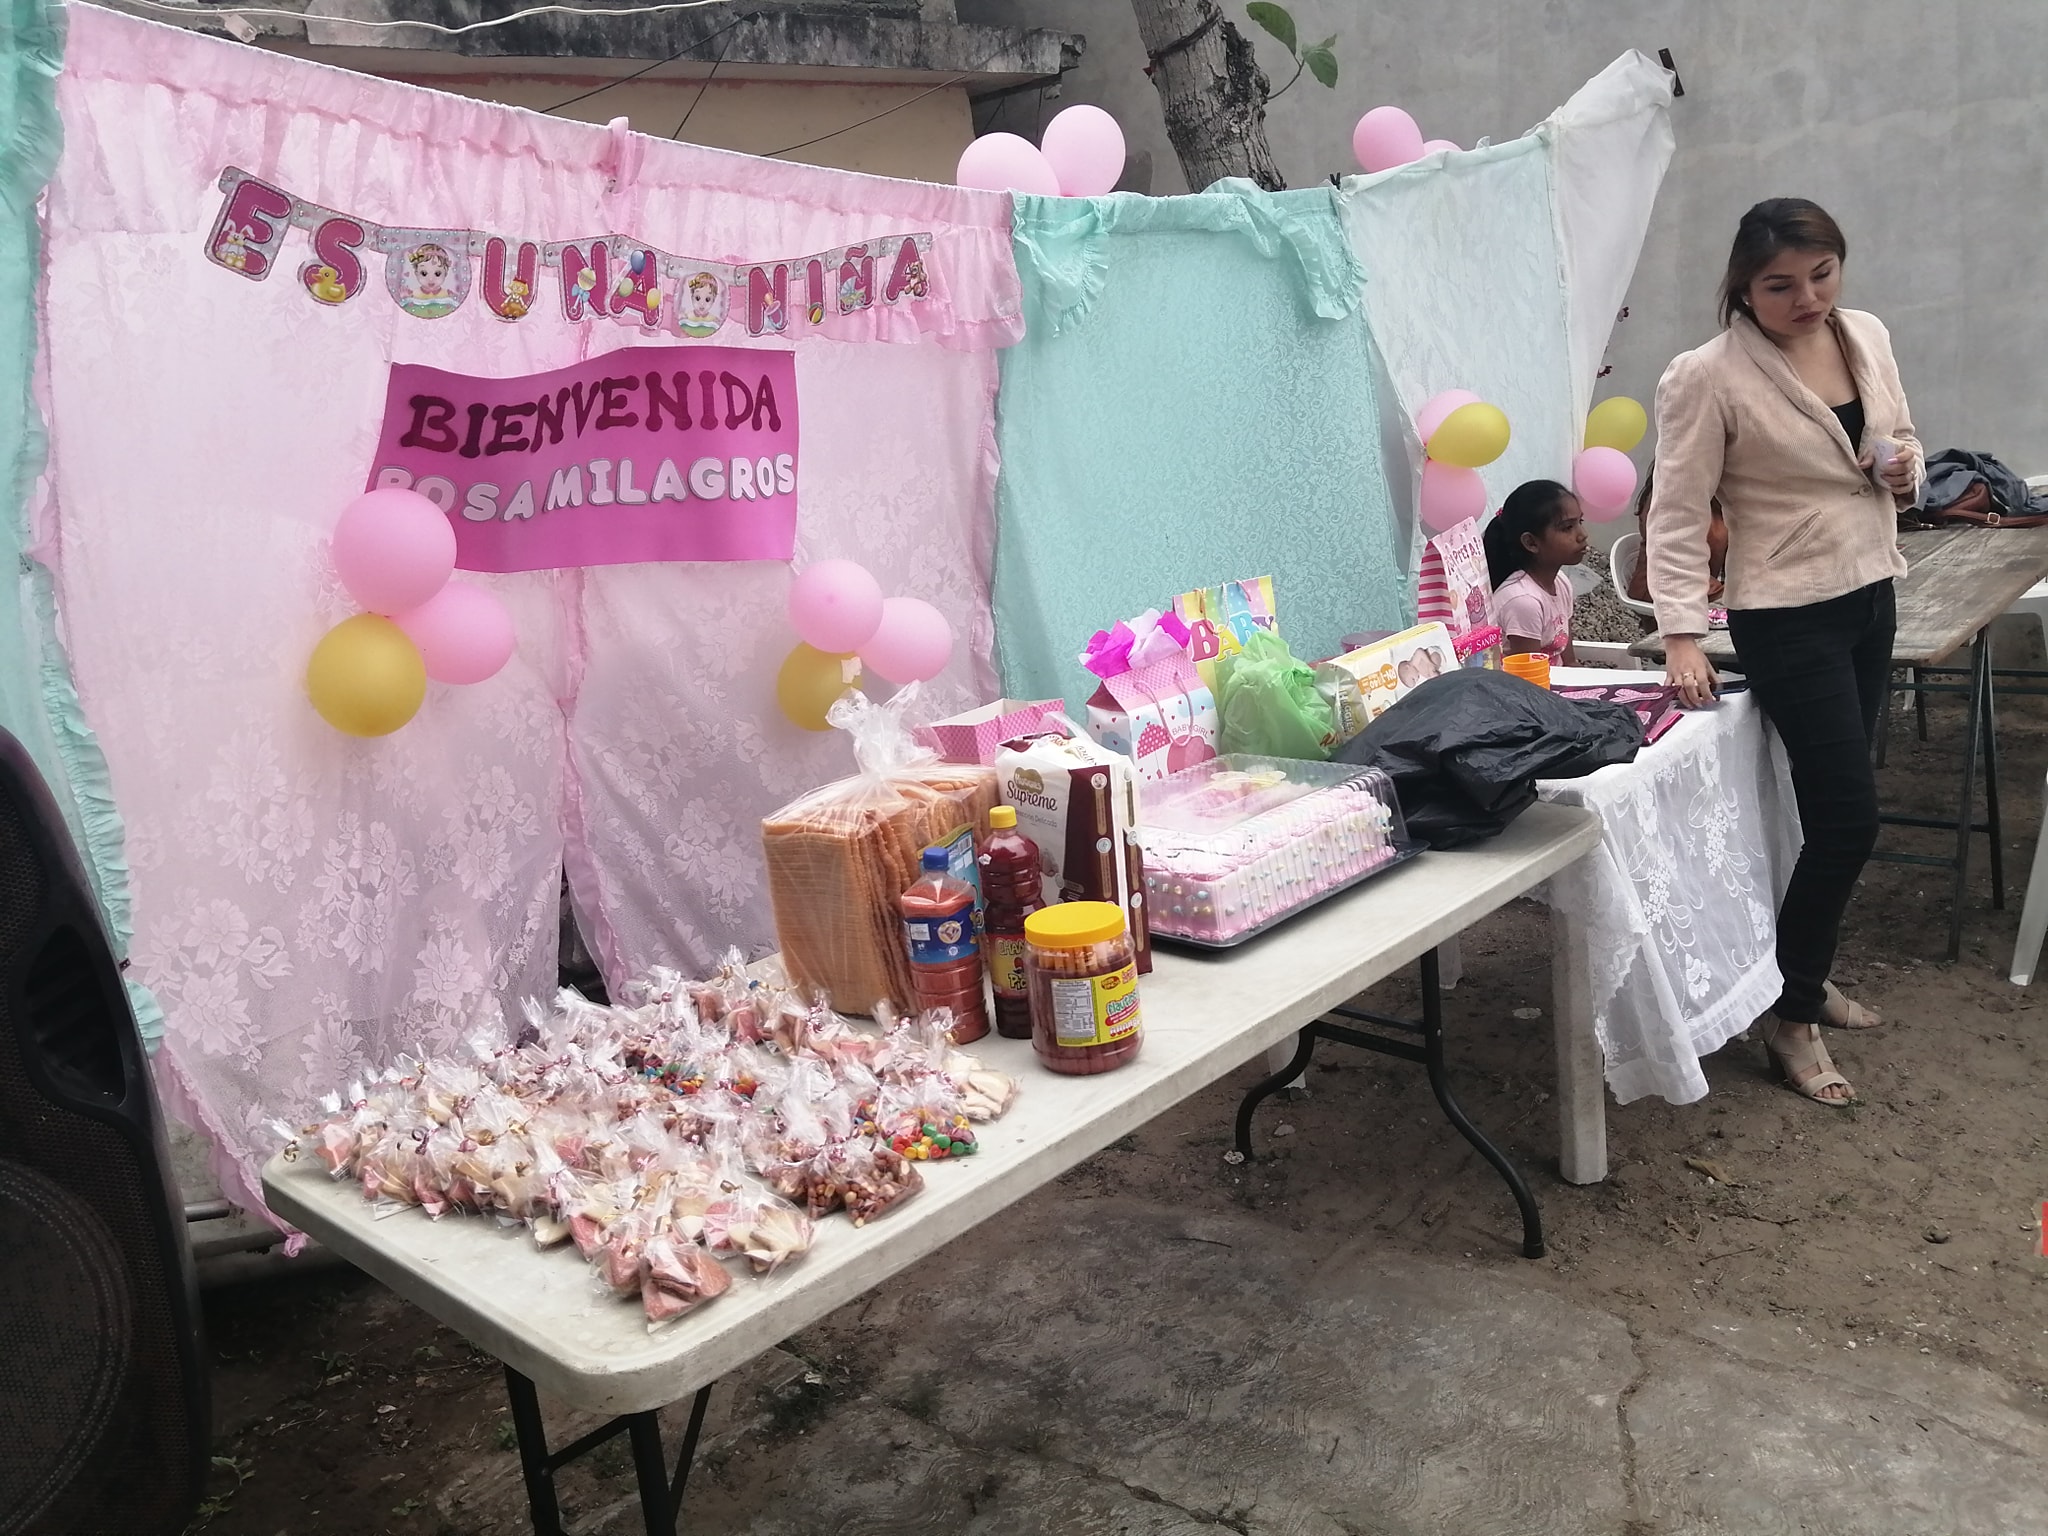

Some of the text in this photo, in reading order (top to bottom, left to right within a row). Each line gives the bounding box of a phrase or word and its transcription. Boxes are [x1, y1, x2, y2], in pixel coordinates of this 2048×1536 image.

[214, 178, 929, 335] ES UNA NIÑA
[399, 370, 782, 459] BIENVENIDA
[1171, 723, 1210, 739] BABY GIRL
[1006, 780, 1058, 812] Supreme
